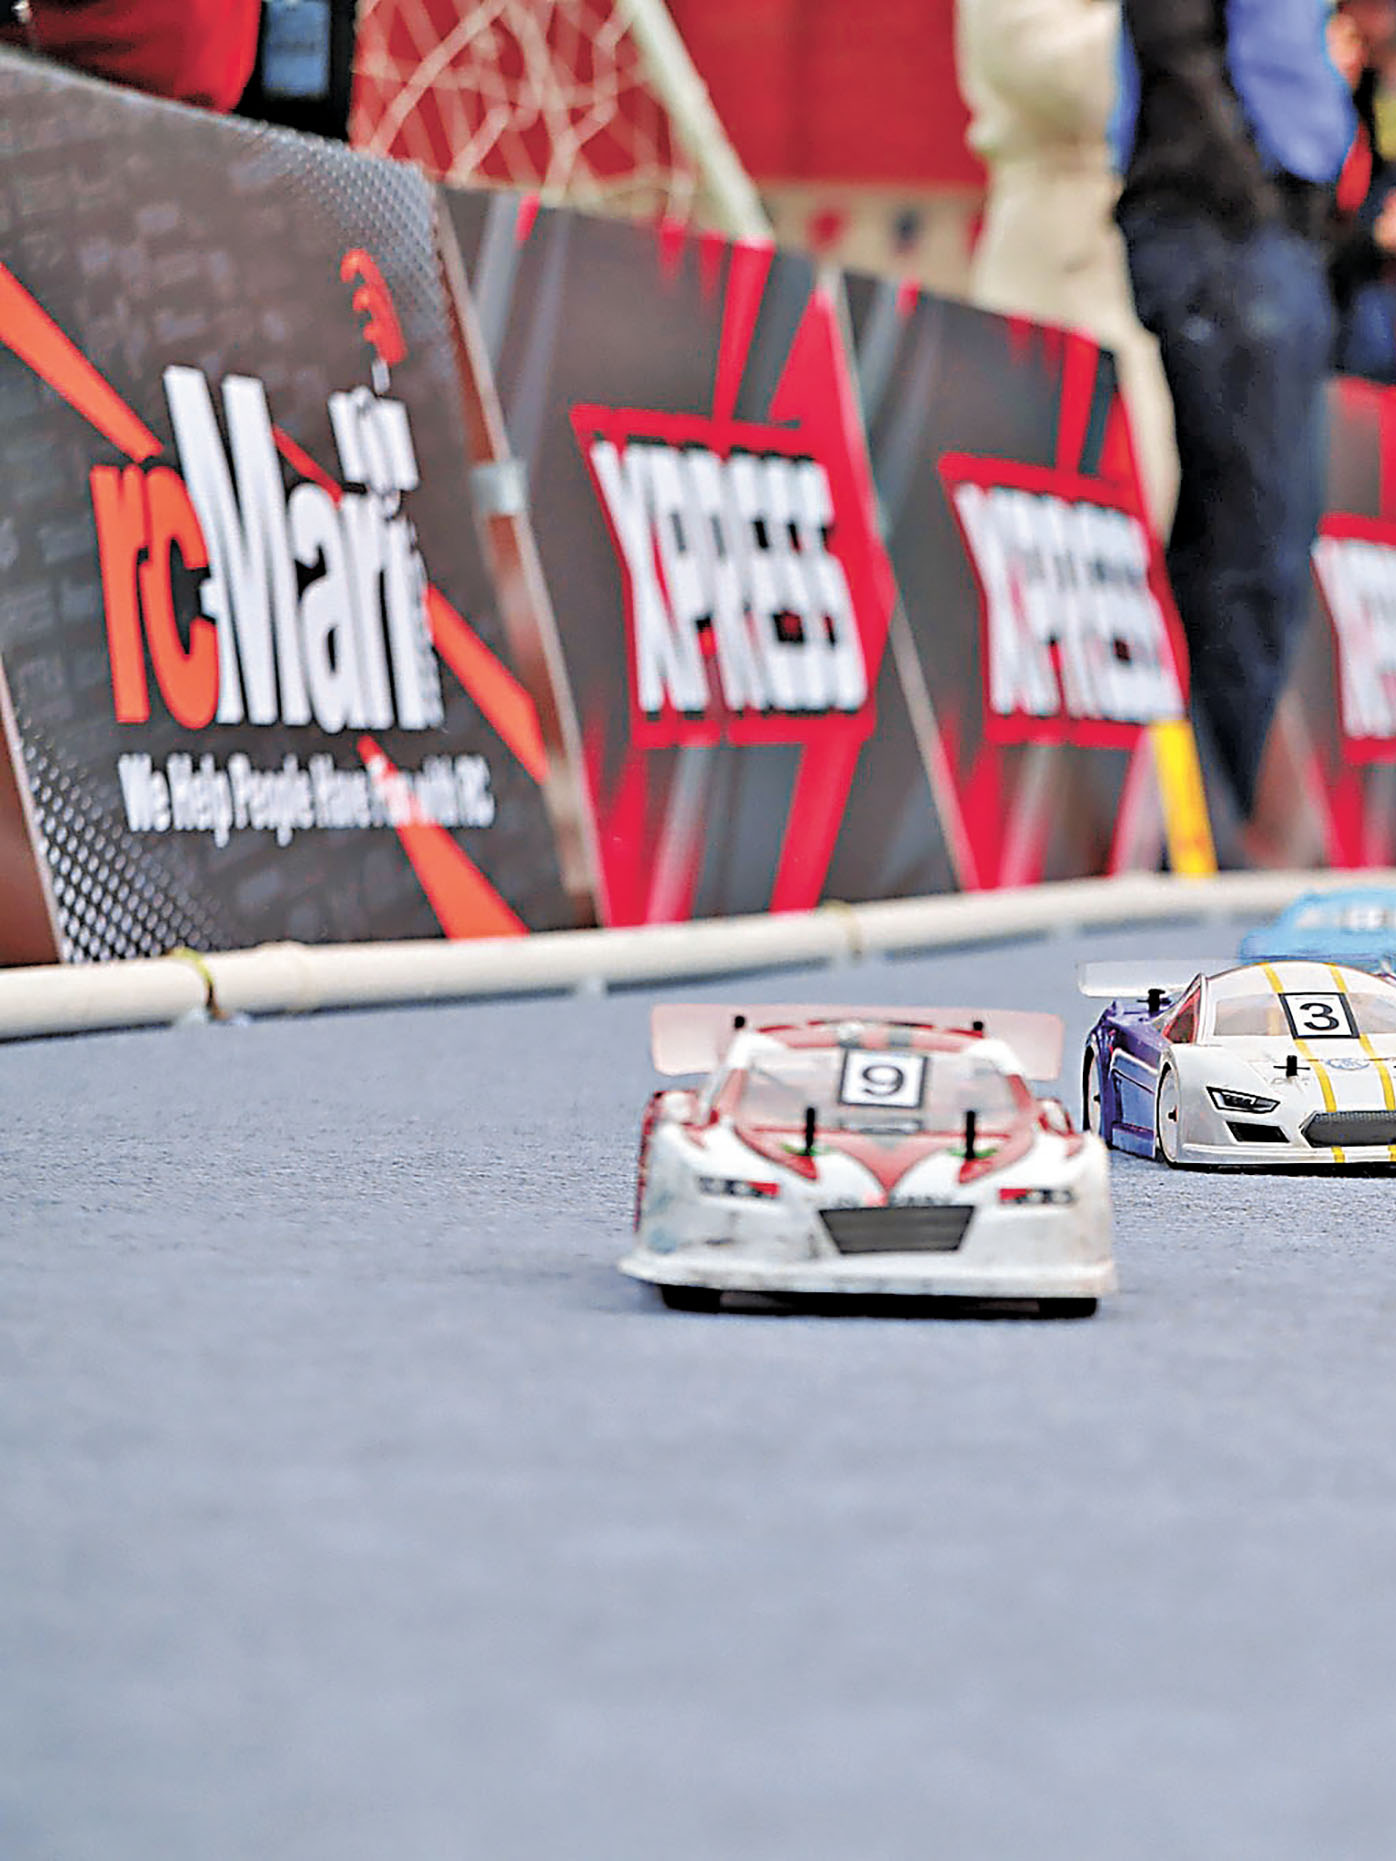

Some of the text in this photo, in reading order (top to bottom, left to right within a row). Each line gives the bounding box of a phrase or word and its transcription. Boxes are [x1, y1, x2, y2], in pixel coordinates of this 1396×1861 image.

[590, 438, 868, 713] XPRESS
[953, 481, 1186, 724] XPRESS
[118, 752, 171, 832] We
[166, 752, 235, 848] Help
[228, 753, 315, 848] People
[1299, 1002, 1340, 1031] 3
[862, 1064, 905, 1096] 9
